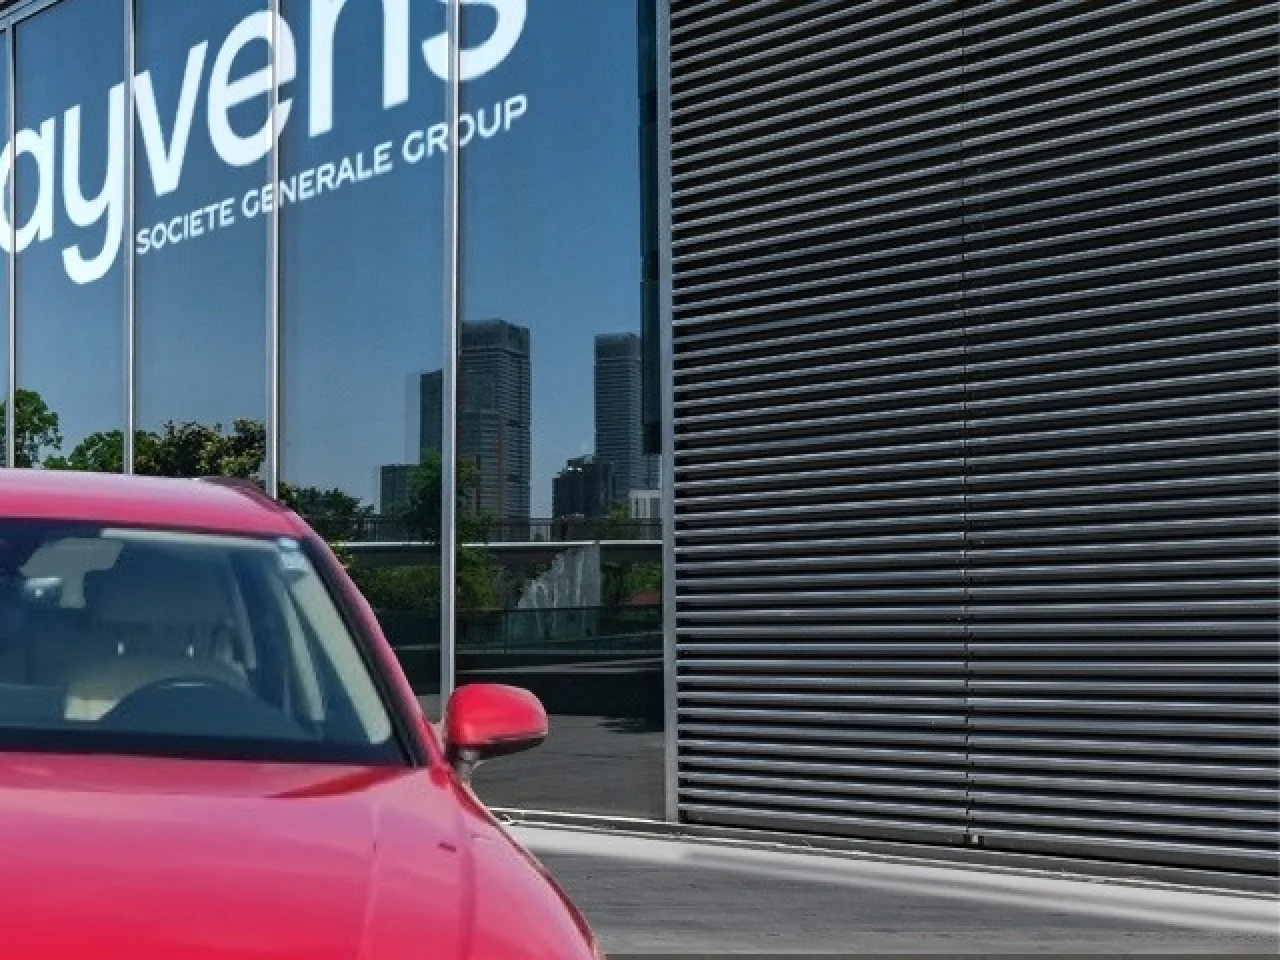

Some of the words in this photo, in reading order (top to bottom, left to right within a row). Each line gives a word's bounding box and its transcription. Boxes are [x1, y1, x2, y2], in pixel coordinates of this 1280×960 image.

[136, 197, 236, 255] SOCIETE
[241, 141, 394, 219] GENERALE
[401, 94, 528, 164] GROUP
